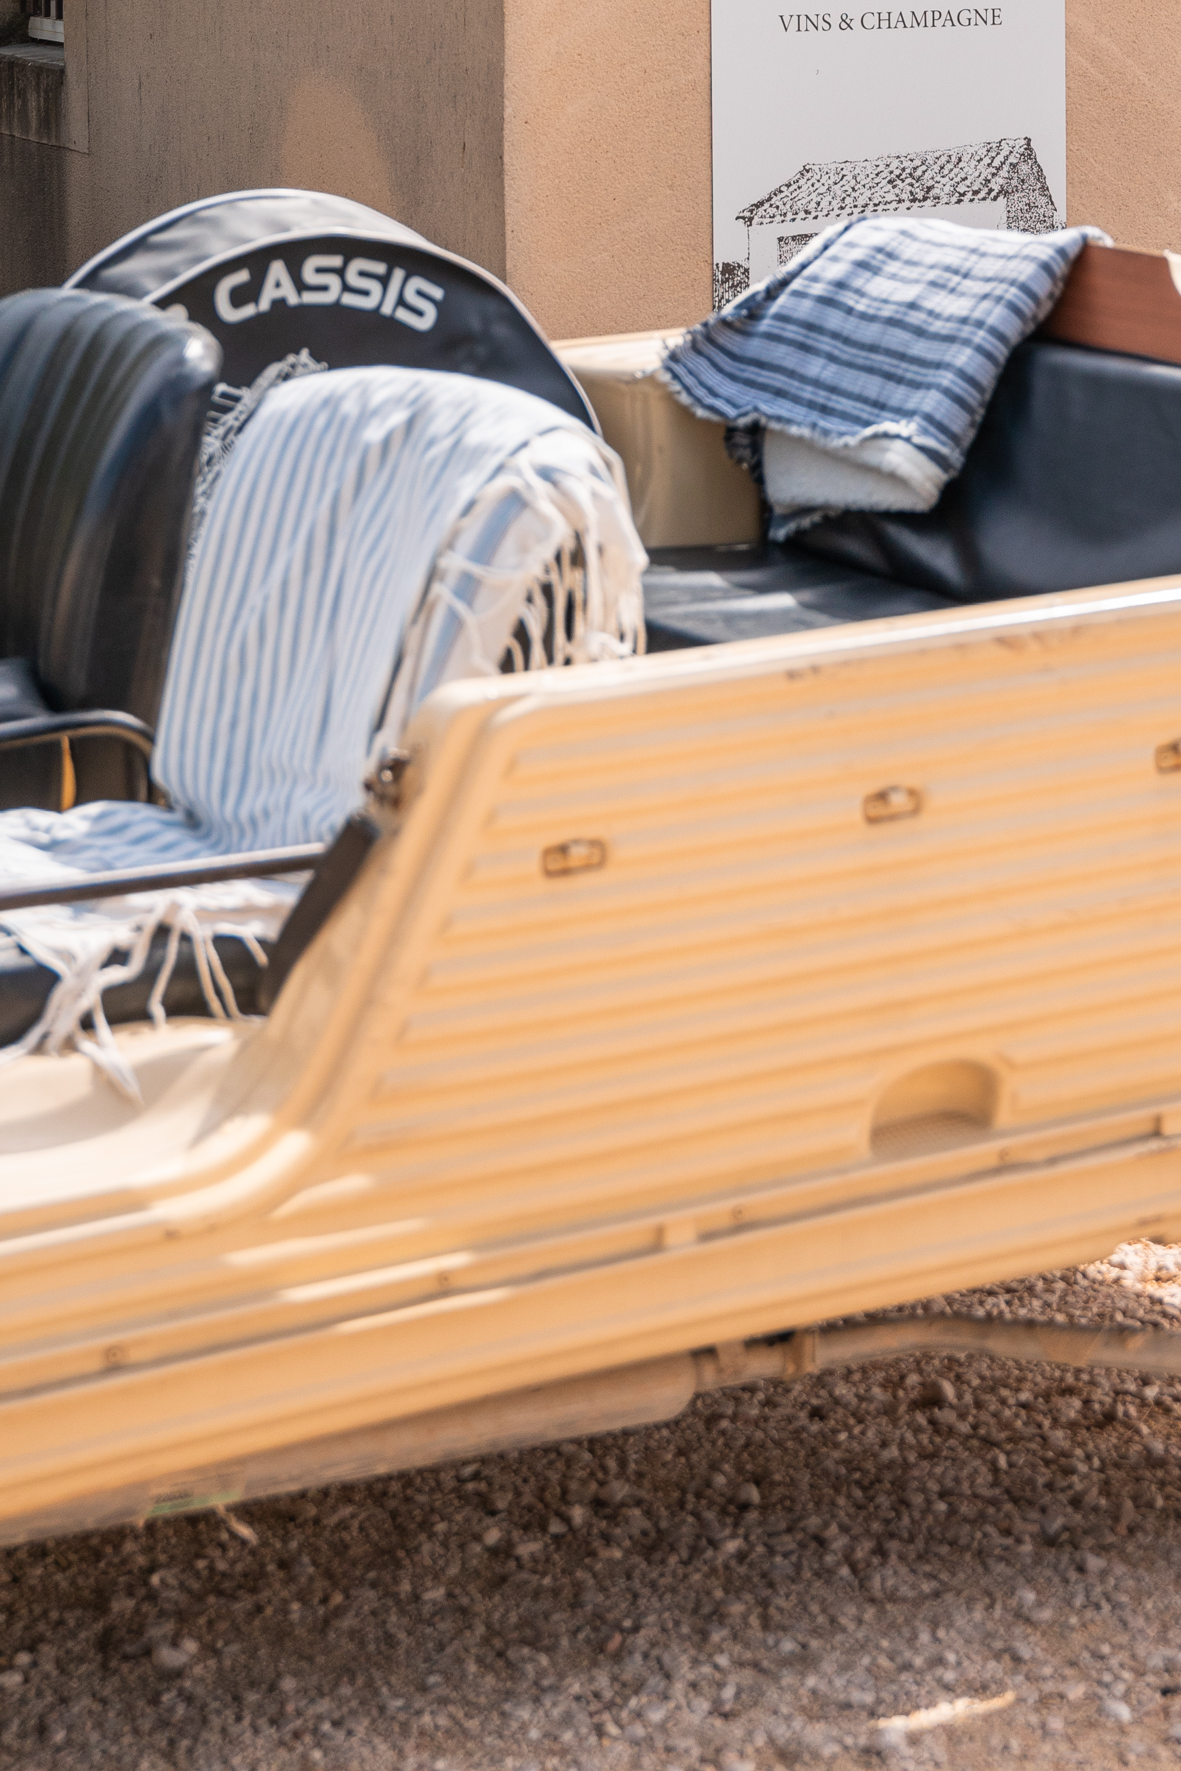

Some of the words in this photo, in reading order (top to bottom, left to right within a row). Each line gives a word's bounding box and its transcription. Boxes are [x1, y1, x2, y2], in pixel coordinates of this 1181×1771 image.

[778, 13, 832, 33] VINS
[838, 12, 855, 31] &
[860, 7, 1003, 31] CHAMPAGNE
[213, 254, 445, 332] CASSIS
